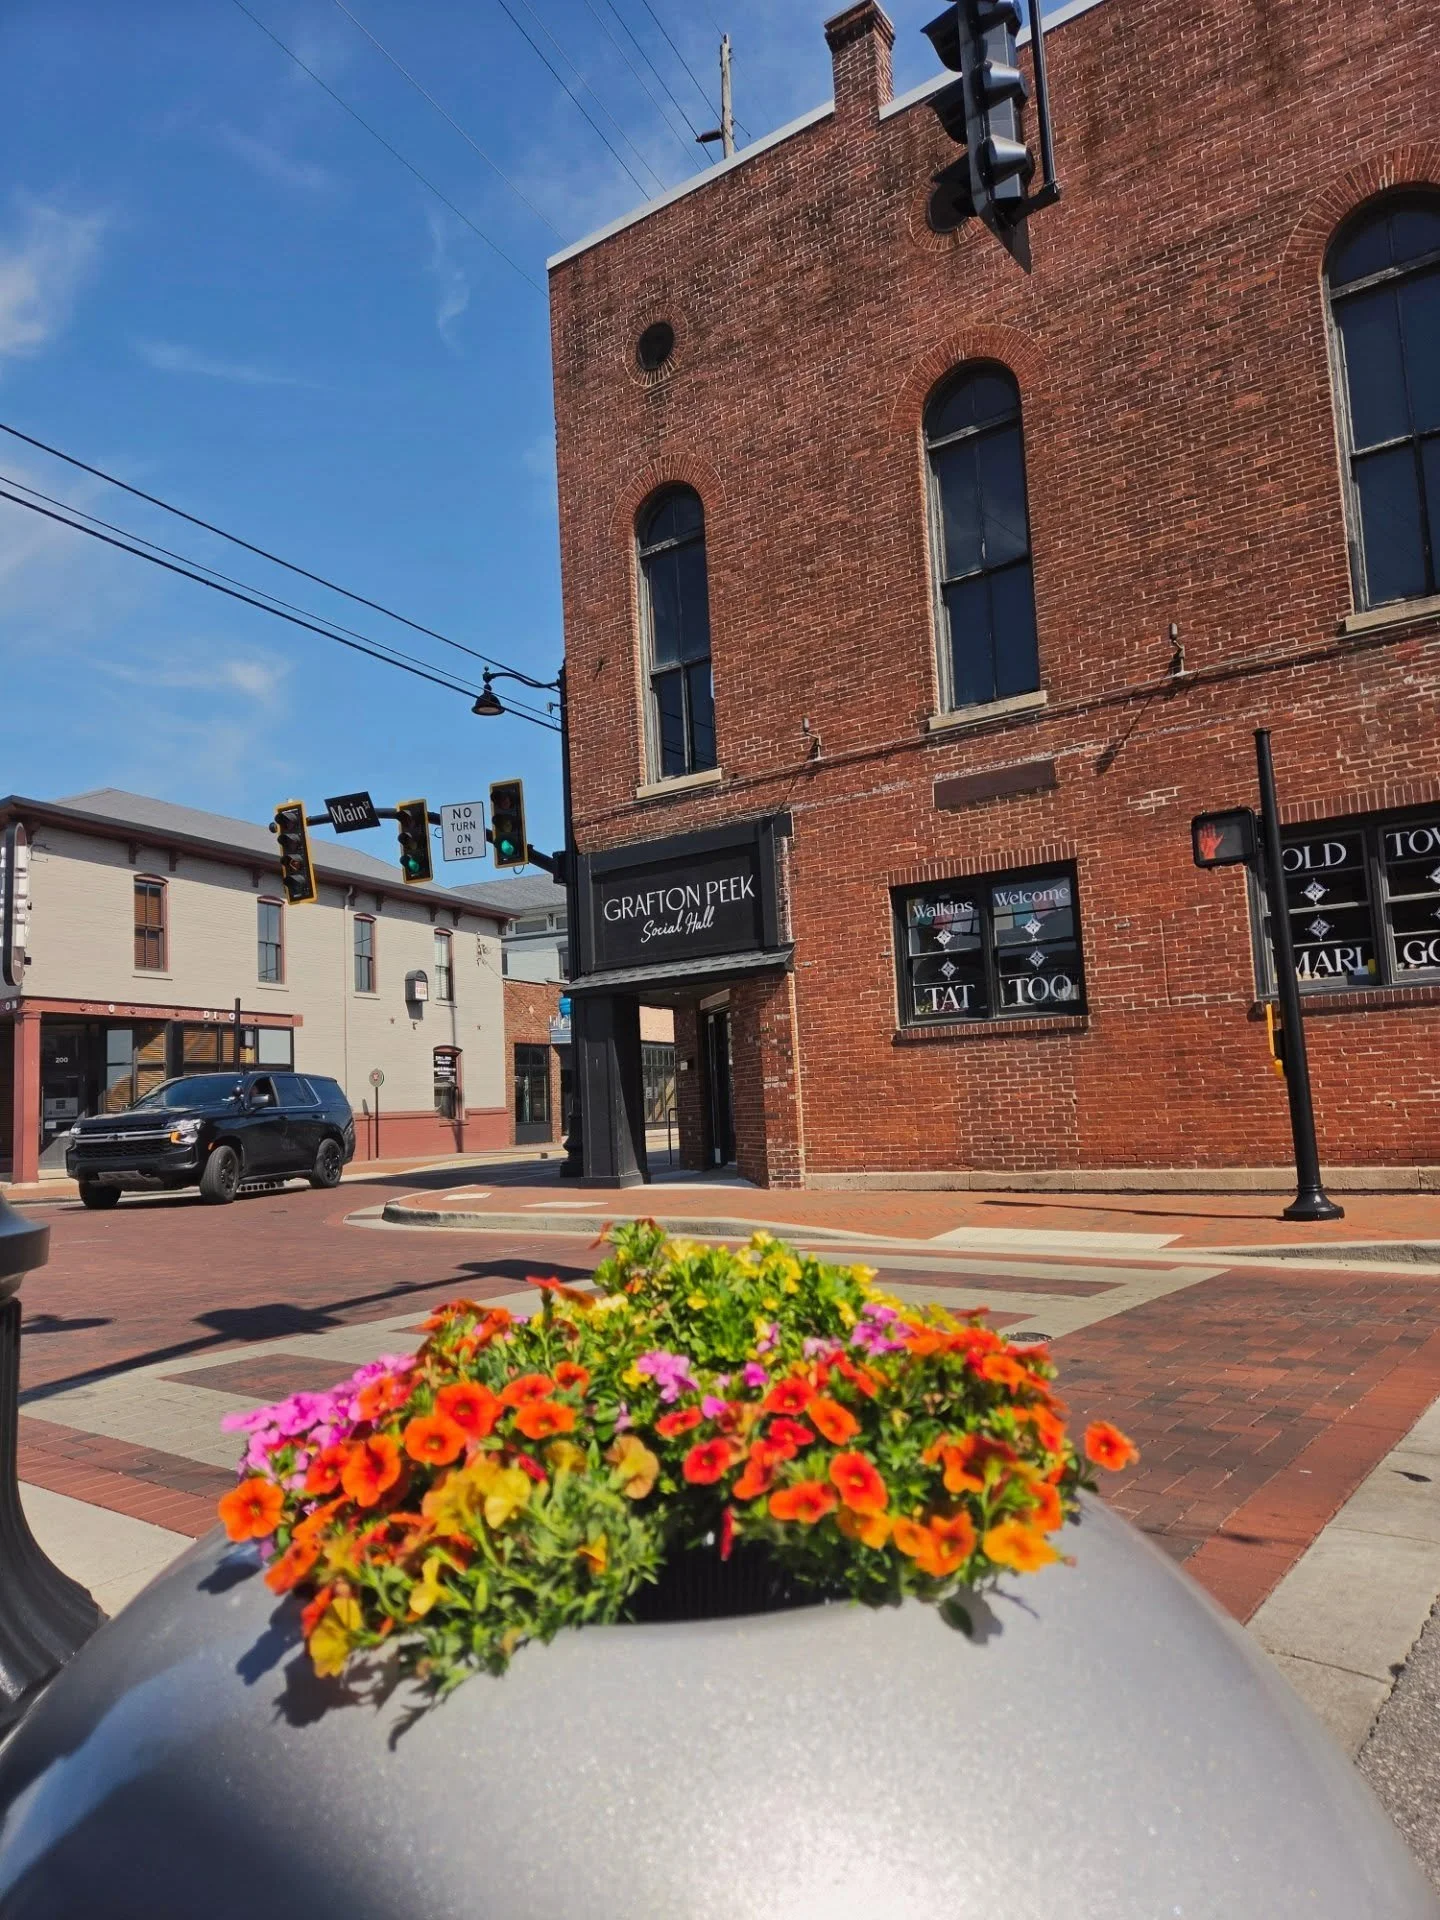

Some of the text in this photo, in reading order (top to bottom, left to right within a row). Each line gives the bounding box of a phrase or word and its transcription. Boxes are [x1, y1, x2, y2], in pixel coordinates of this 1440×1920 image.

[330, 803, 367, 824] Main
[452, 807, 472, 819] NO
[451, 821, 476, 832] TURN
[457, 834, 471, 843] ON
[455, 846, 474, 856] RED
[1282, 827, 1440, 871] OLD TO
[604, 874, 755, 921] GRAFTON PEEK
[913, 887, 1069, 919] Walkins Welcome
[640, 905, 715, 943] Social Hall
[924, 974, 1072, 1012] TAT TOO
